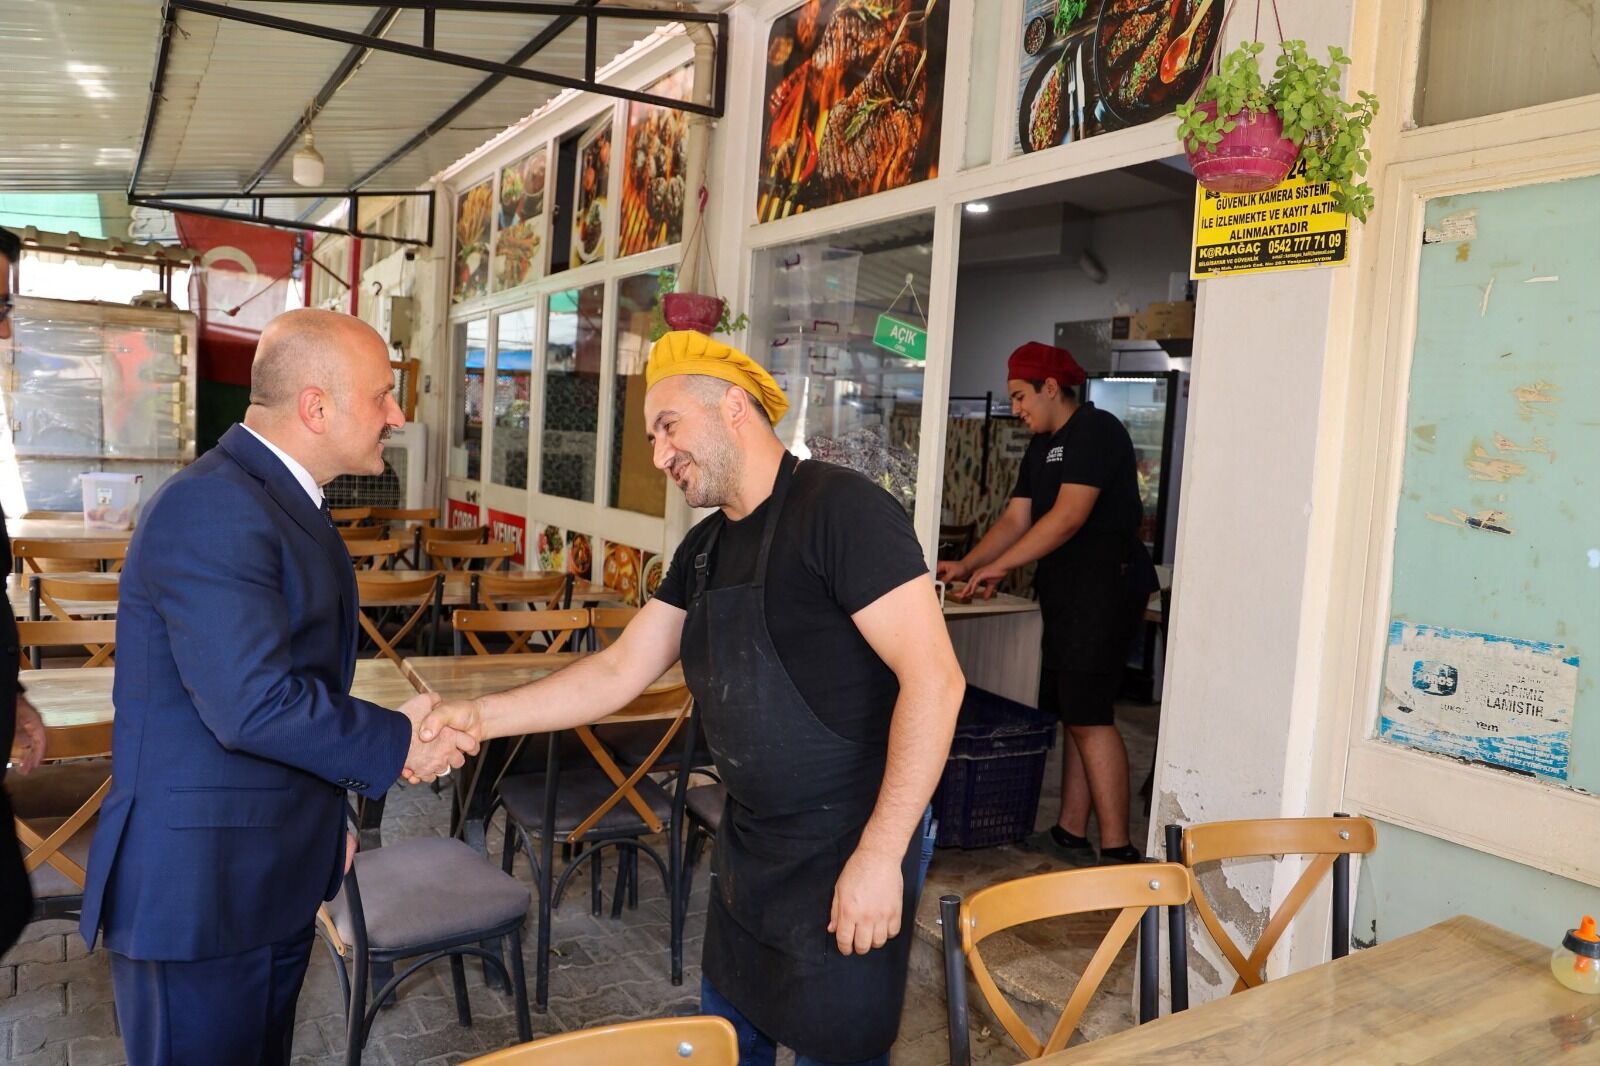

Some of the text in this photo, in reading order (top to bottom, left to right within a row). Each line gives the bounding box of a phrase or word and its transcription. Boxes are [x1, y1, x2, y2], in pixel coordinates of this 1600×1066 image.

[1258, 188, 1293, 205] KAMERA
[1215, 210, 1267, 227] İZLENMEKTE
[1269, 209, 1280, 220] VE
[1282, 204, 1308, 219] KAYIT
[1310, 200, 1338, 215] ALTIN
[1230, 221, 1309, 241] ALINMAKTADIR
[1268, 238, 1291, 255] 0542
[1294, 236, 1312, 252] 777
[1314, 234, 1326, 250] 71
[1328, 233, 1341, 249] 09
[889, 324, 918, 347] AÇIK
